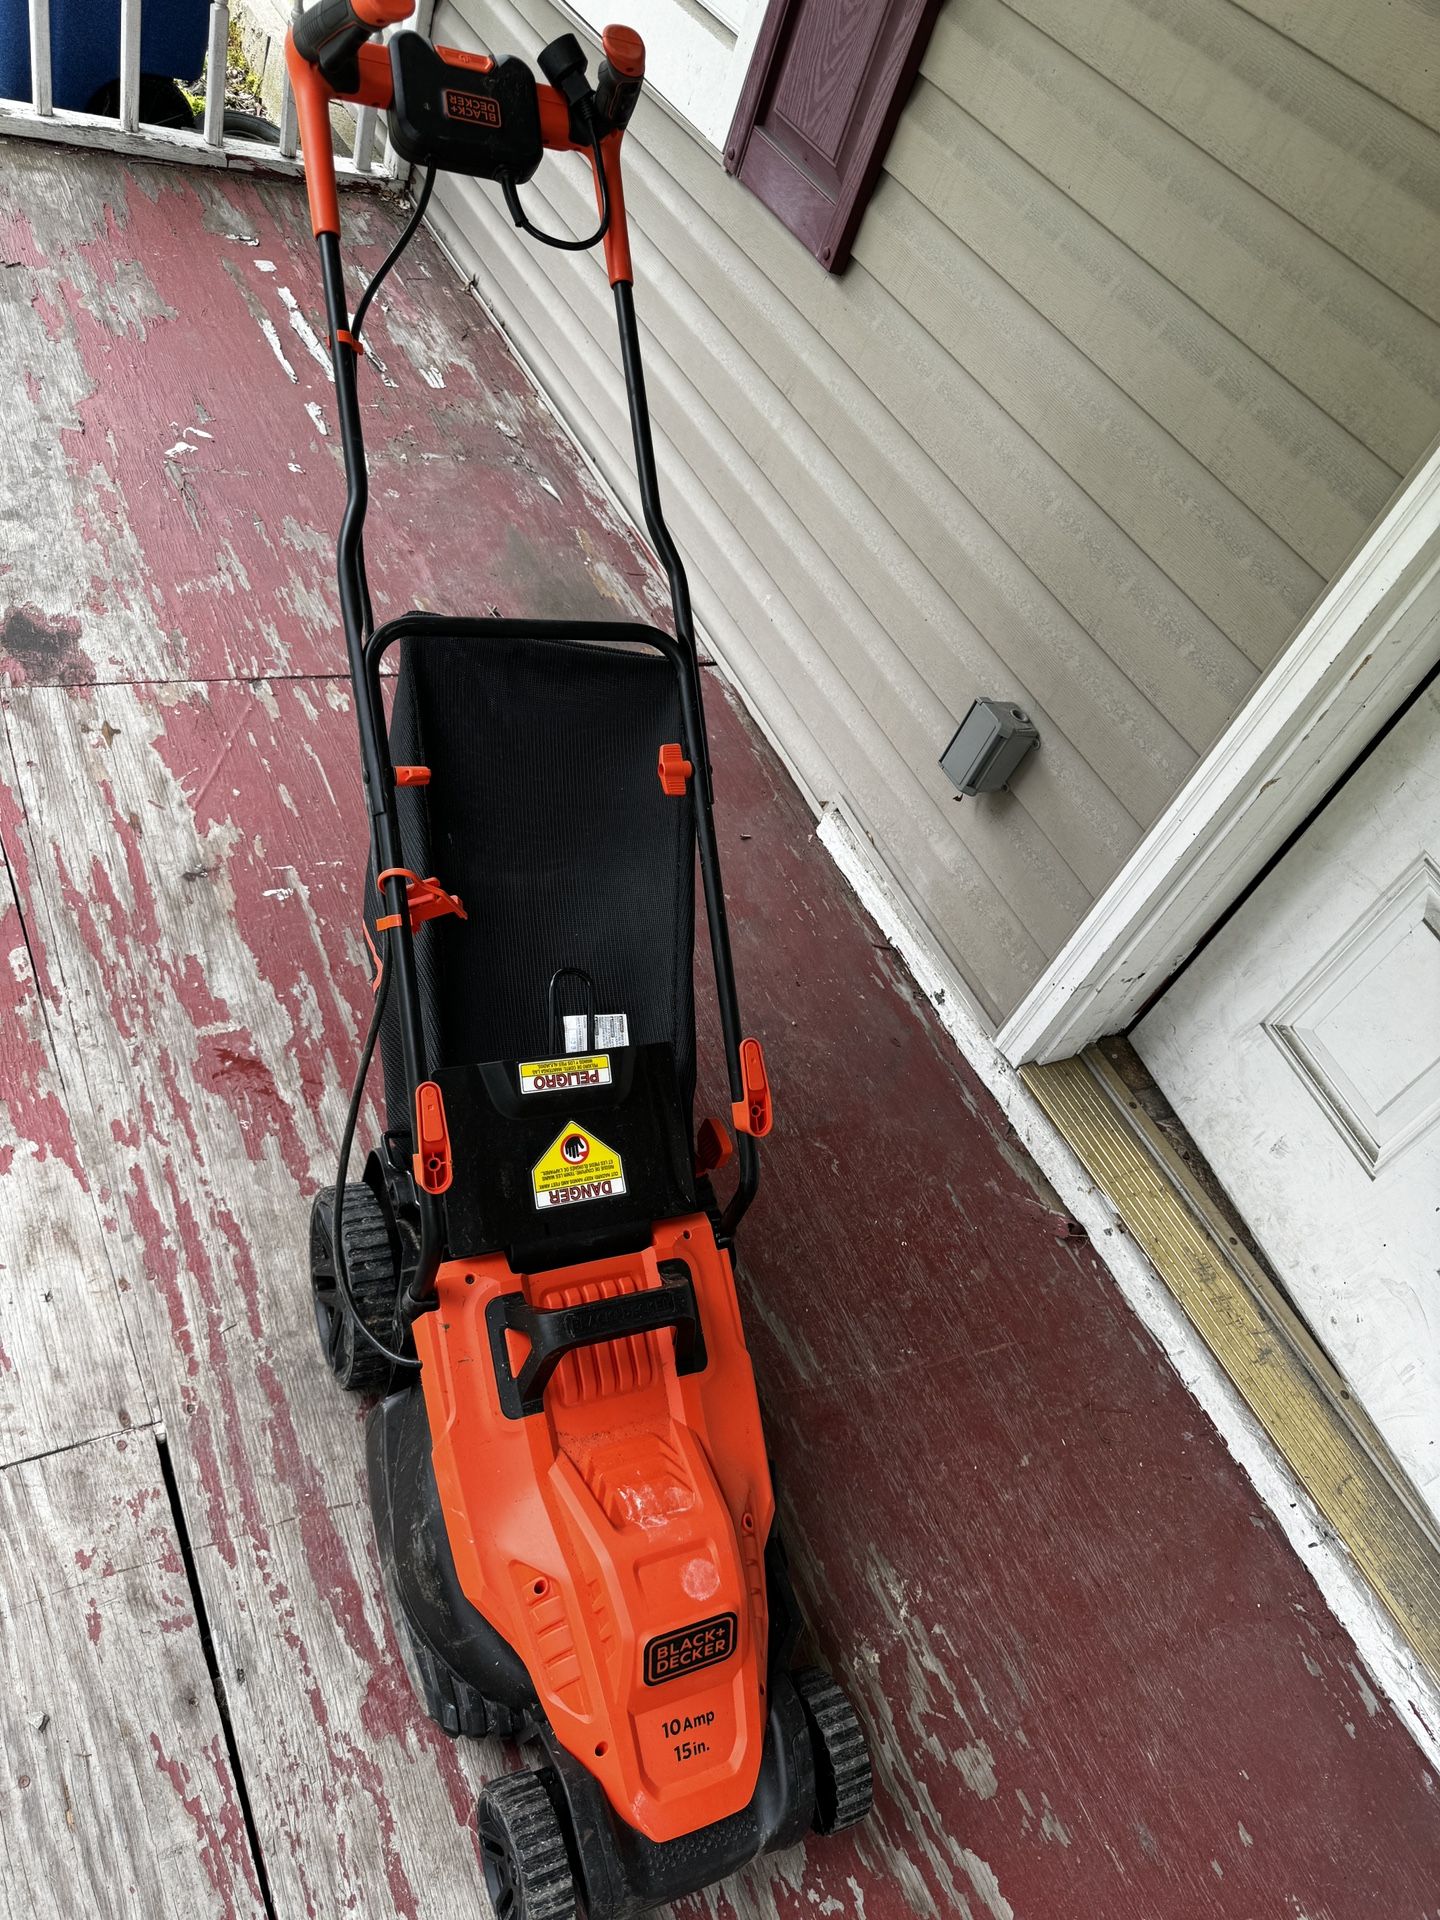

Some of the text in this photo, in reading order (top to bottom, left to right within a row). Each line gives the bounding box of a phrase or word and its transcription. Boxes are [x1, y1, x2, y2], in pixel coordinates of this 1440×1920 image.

[449, 95, 495, 112] DECKER
[451, 106, 496, 121] BLACK+
[534, 1070, 599, 1090] PELIGRO
[549, 1181, 612, 1205] DANGER
[657, 1628, 726, 1659] BLACK+
[657, 1640, 726, 1674] DECKER
[662, 1711, 714, 1738] 10 Amp
[674, 1742, 710, 1761] 15 in.
